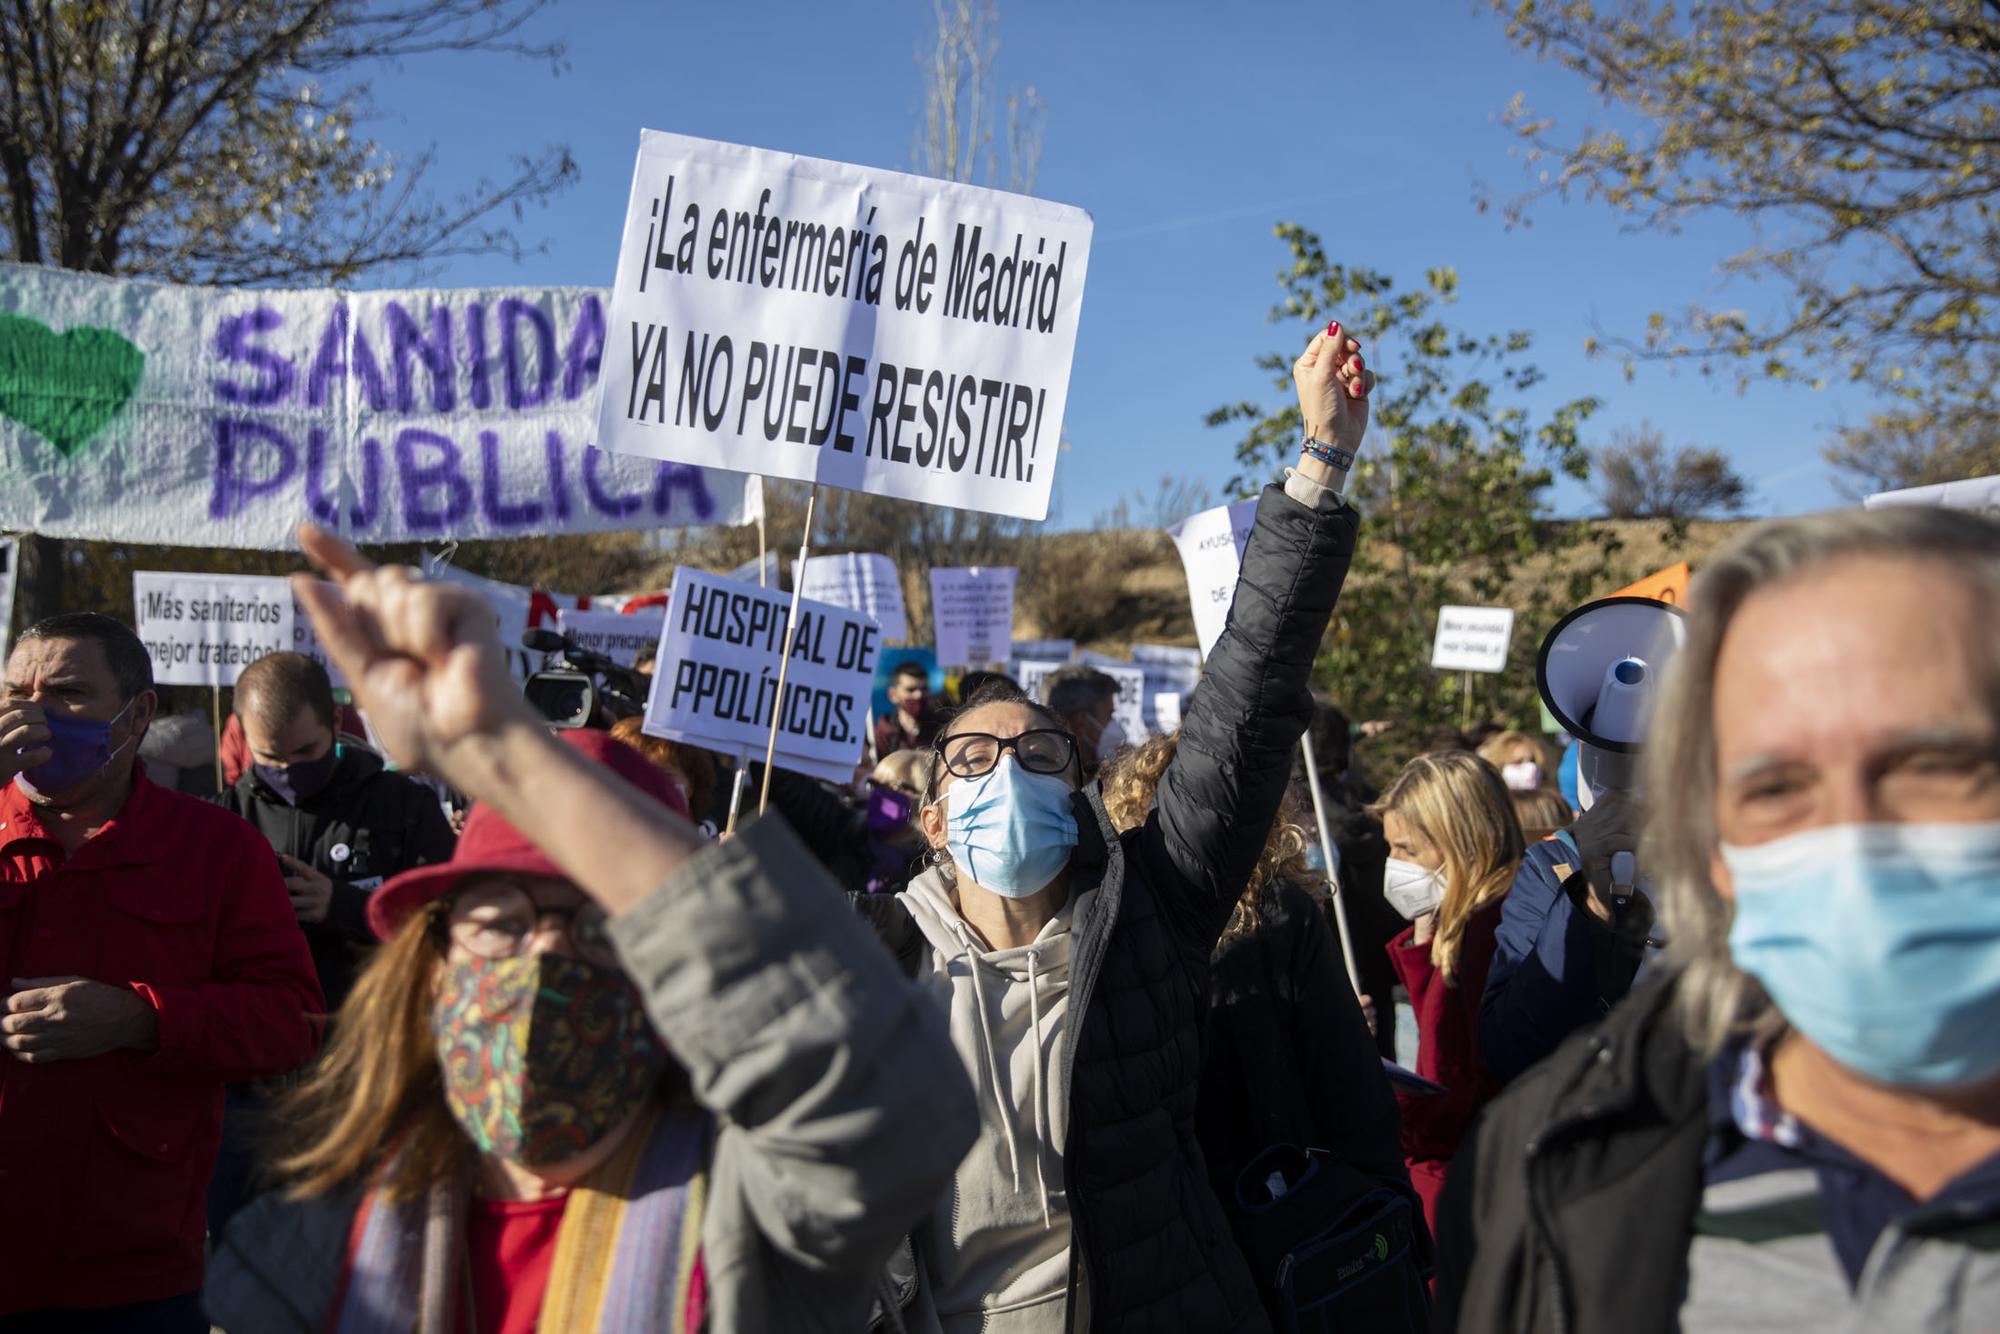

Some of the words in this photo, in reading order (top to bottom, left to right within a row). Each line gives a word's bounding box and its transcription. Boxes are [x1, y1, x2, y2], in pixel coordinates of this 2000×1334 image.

[639, 174, 701, 293] ¡La
[706, 188, 889, 306] enfermería
[895, 216, 938, 314] de
[943, 223, 1067, 333] Madrid
[627, 321, 669, 425] YA
[675, 330, 734, 432] NO
[737, 340, 866, 454] PUEDE
[866, 362, 1047, 483] RESISTIR!
[208, 419, 714, 530] PUBLICA
[140, 591, 184, 625] ¡Más
[190, 594, 280, 624] sanitarios
[144, 635, 194, 669] mejor
[680, 583, 826, 664] HOSPITAL
[836, 620, 878, 674] DE
[671, 659, 857, 744] PPOLÍTICOS.
